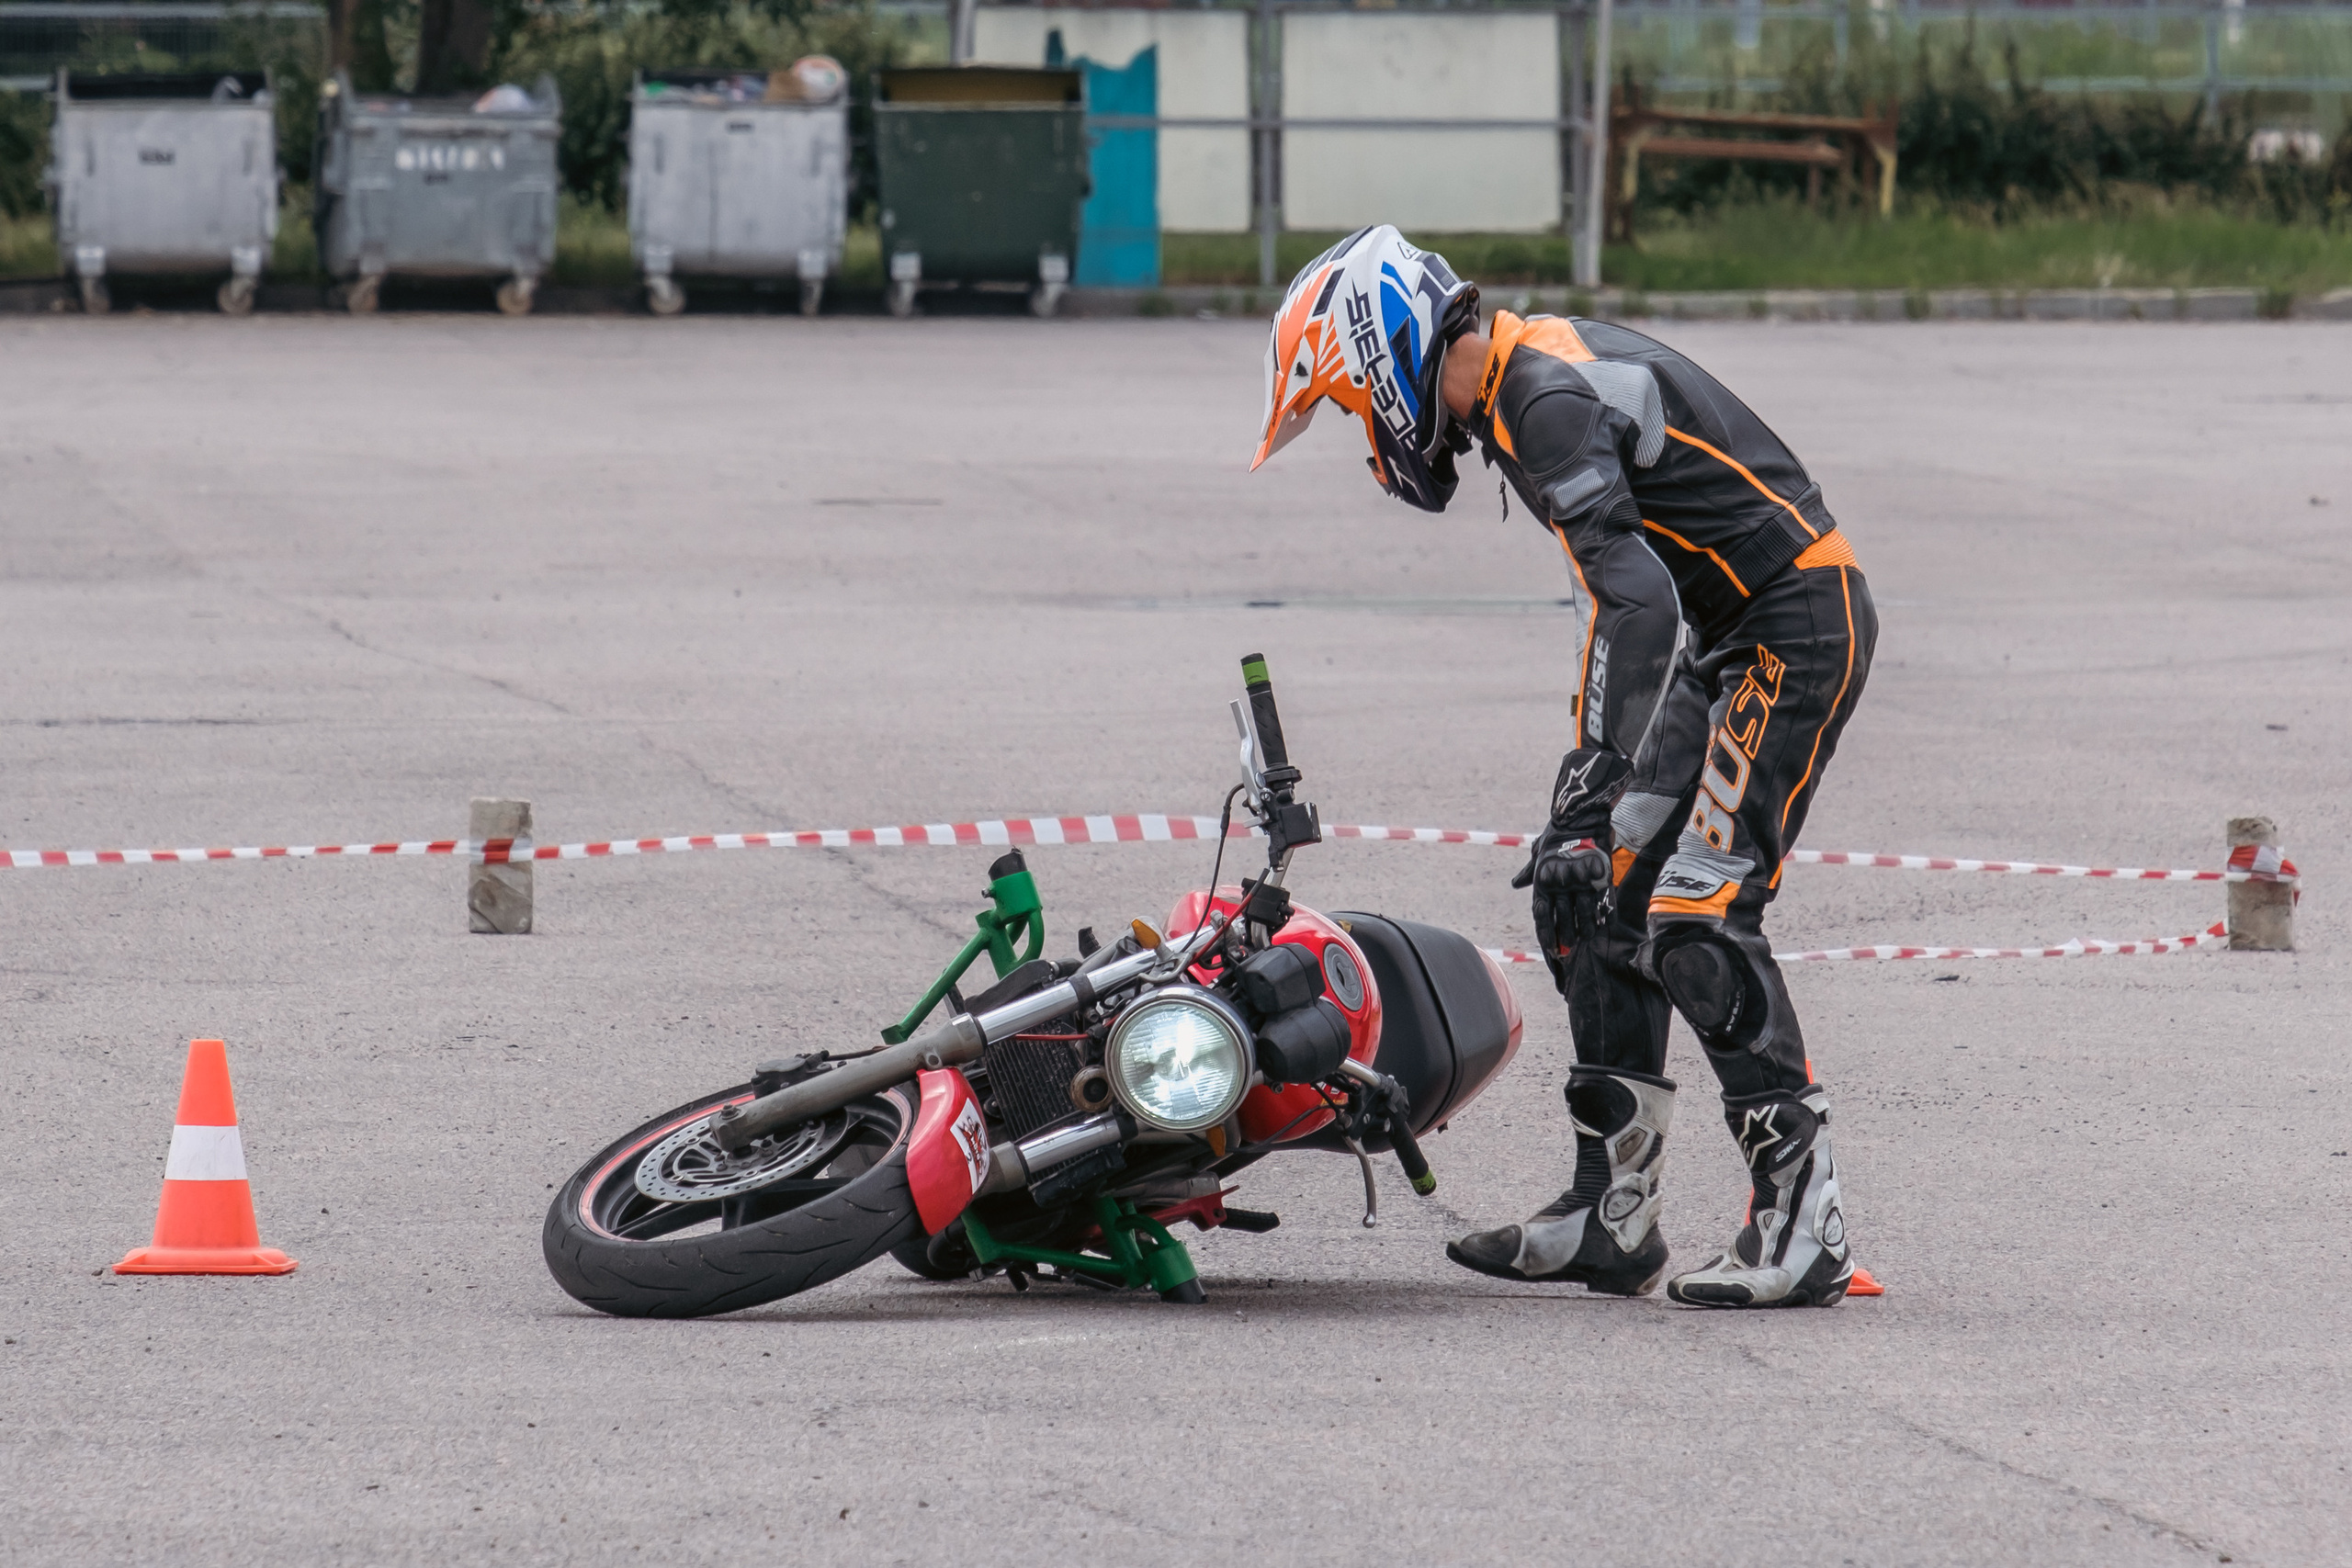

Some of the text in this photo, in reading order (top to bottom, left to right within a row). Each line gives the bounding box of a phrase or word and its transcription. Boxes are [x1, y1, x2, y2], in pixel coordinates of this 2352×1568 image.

[1587, 634, 1610, 743] BÜSE
[1686, 643, 1786, 853] BÜSE
[1655, 870, 1715, 892] ÜSE
